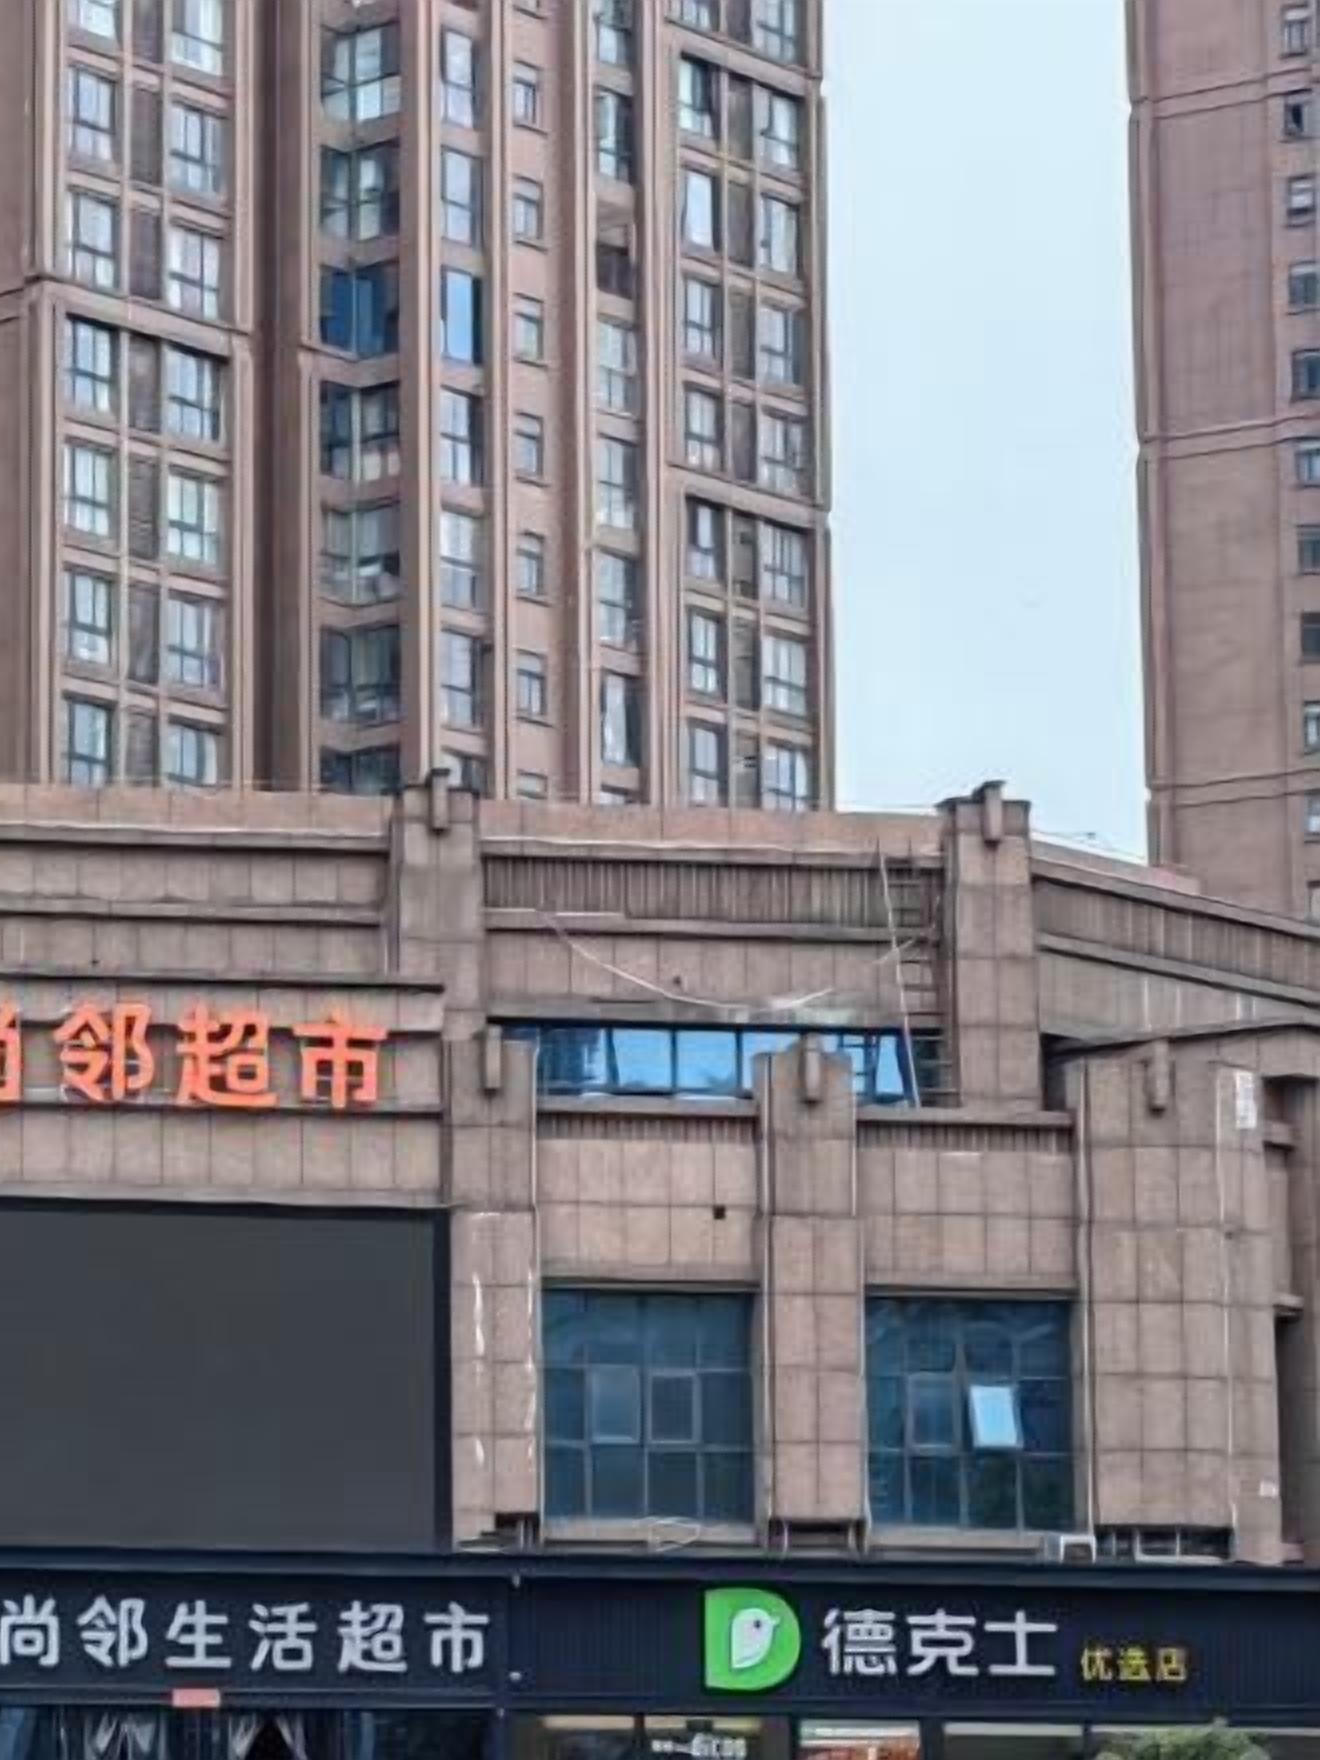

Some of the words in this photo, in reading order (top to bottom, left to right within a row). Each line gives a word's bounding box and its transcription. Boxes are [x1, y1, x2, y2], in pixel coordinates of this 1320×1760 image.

[821, 1608, 1059, 1677] 德克士
[1080, 1645, 1188, 1682] 优选店
